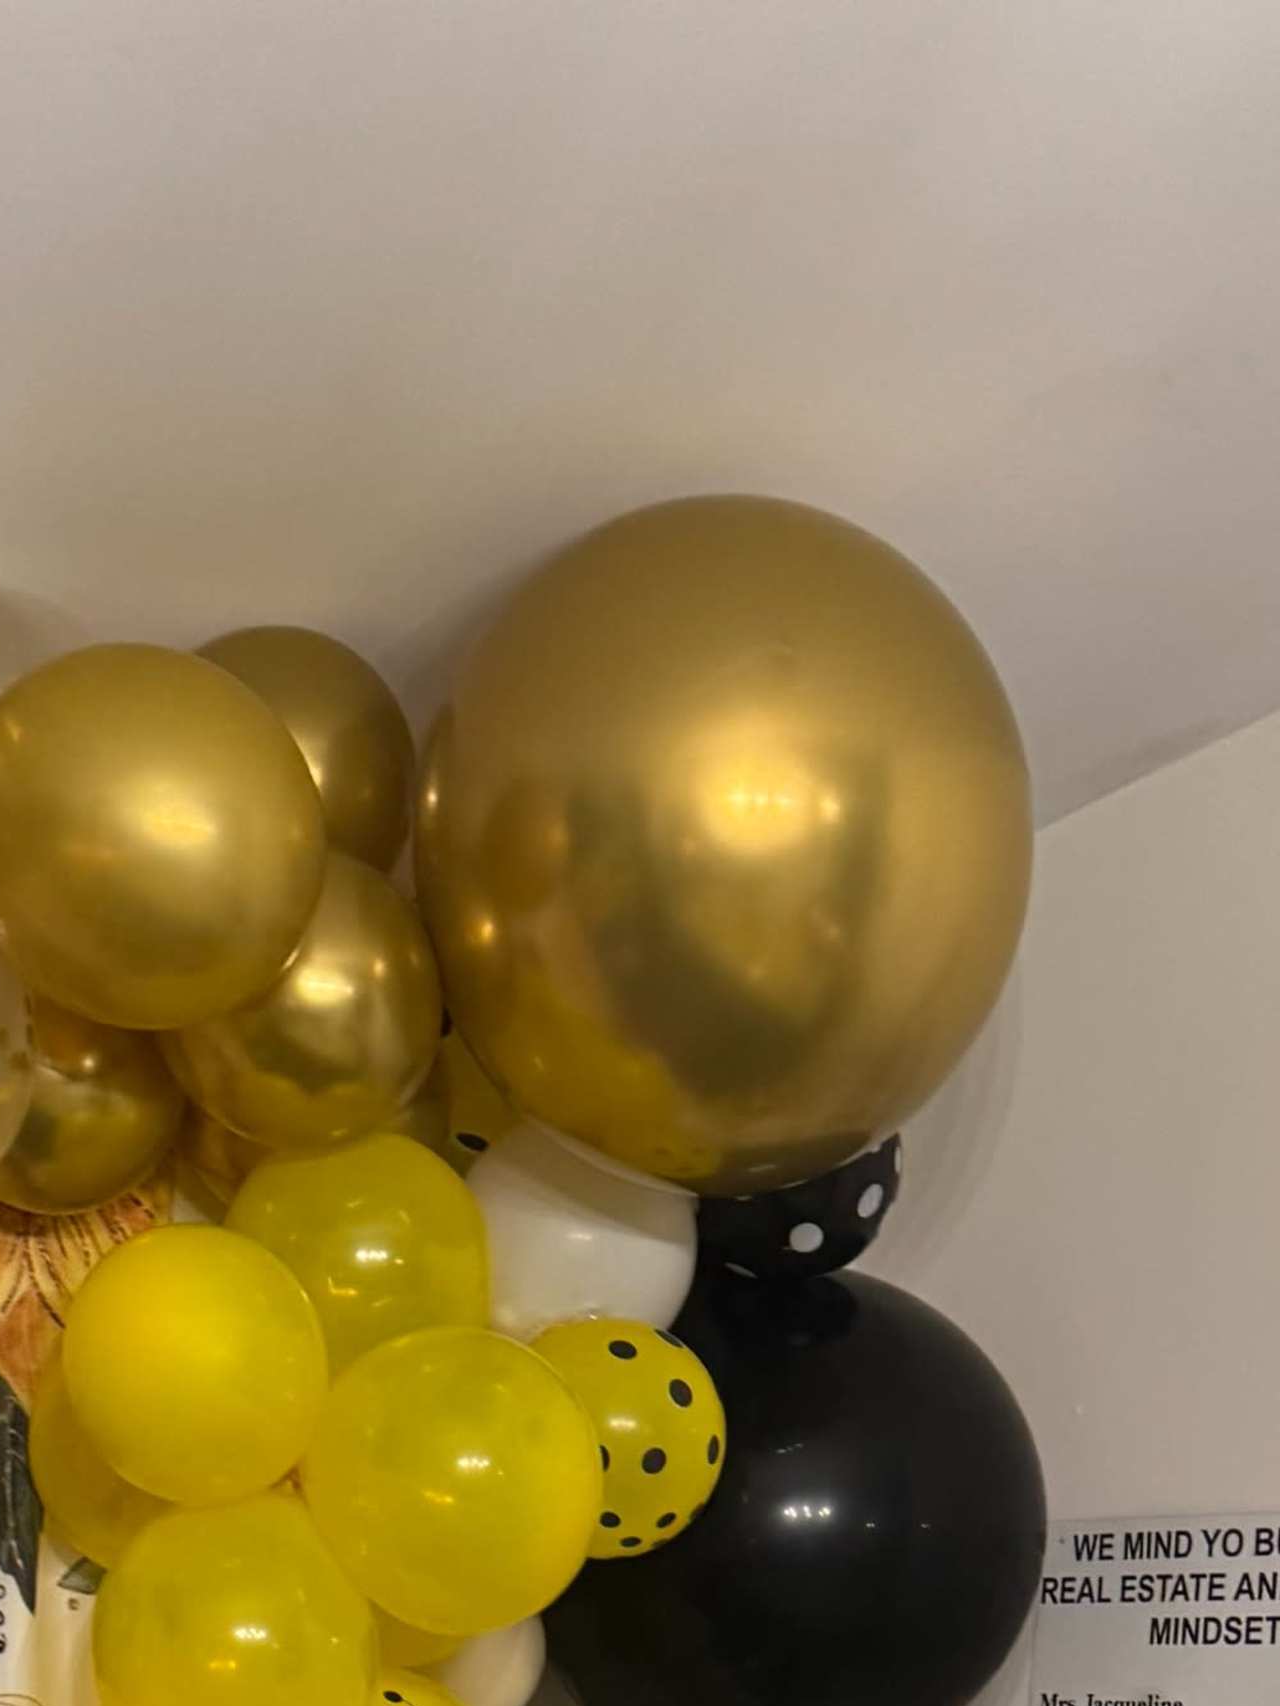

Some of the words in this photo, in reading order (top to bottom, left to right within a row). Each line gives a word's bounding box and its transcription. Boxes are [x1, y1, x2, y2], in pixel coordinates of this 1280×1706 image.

[1072, 1532, 1115, 1562] WE
[1122, 1529, 1194, 1561] MIND
[1200, 1527, 1245, 1558] YO
[1040, 1576, 1112, 1605] REAL
[1119, 1572, 1227, 1604] ESTATE
